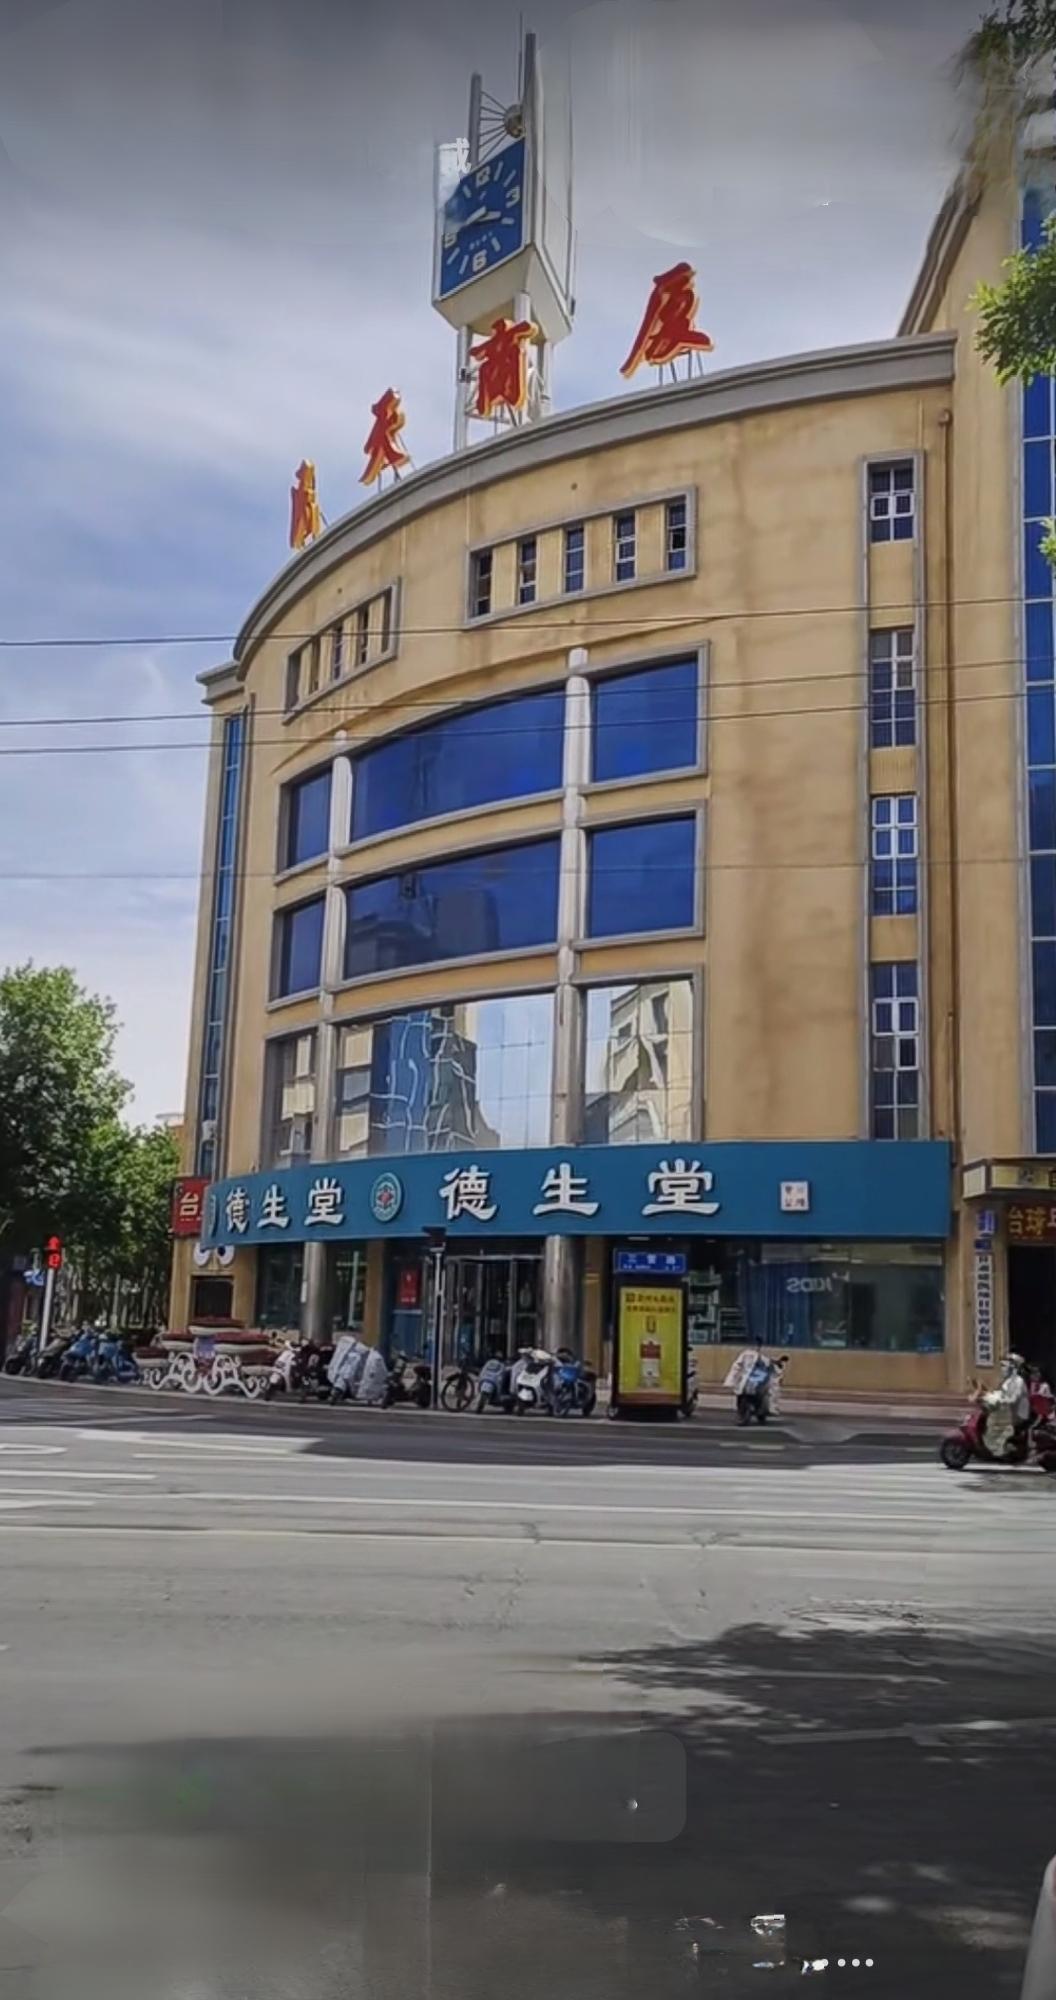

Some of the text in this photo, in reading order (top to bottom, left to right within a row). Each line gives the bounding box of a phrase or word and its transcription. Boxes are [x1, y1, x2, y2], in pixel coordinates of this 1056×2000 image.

[226, 1177, 344, 1234] 德生堂
[438, 1157, 721, 1222] 德生堂
